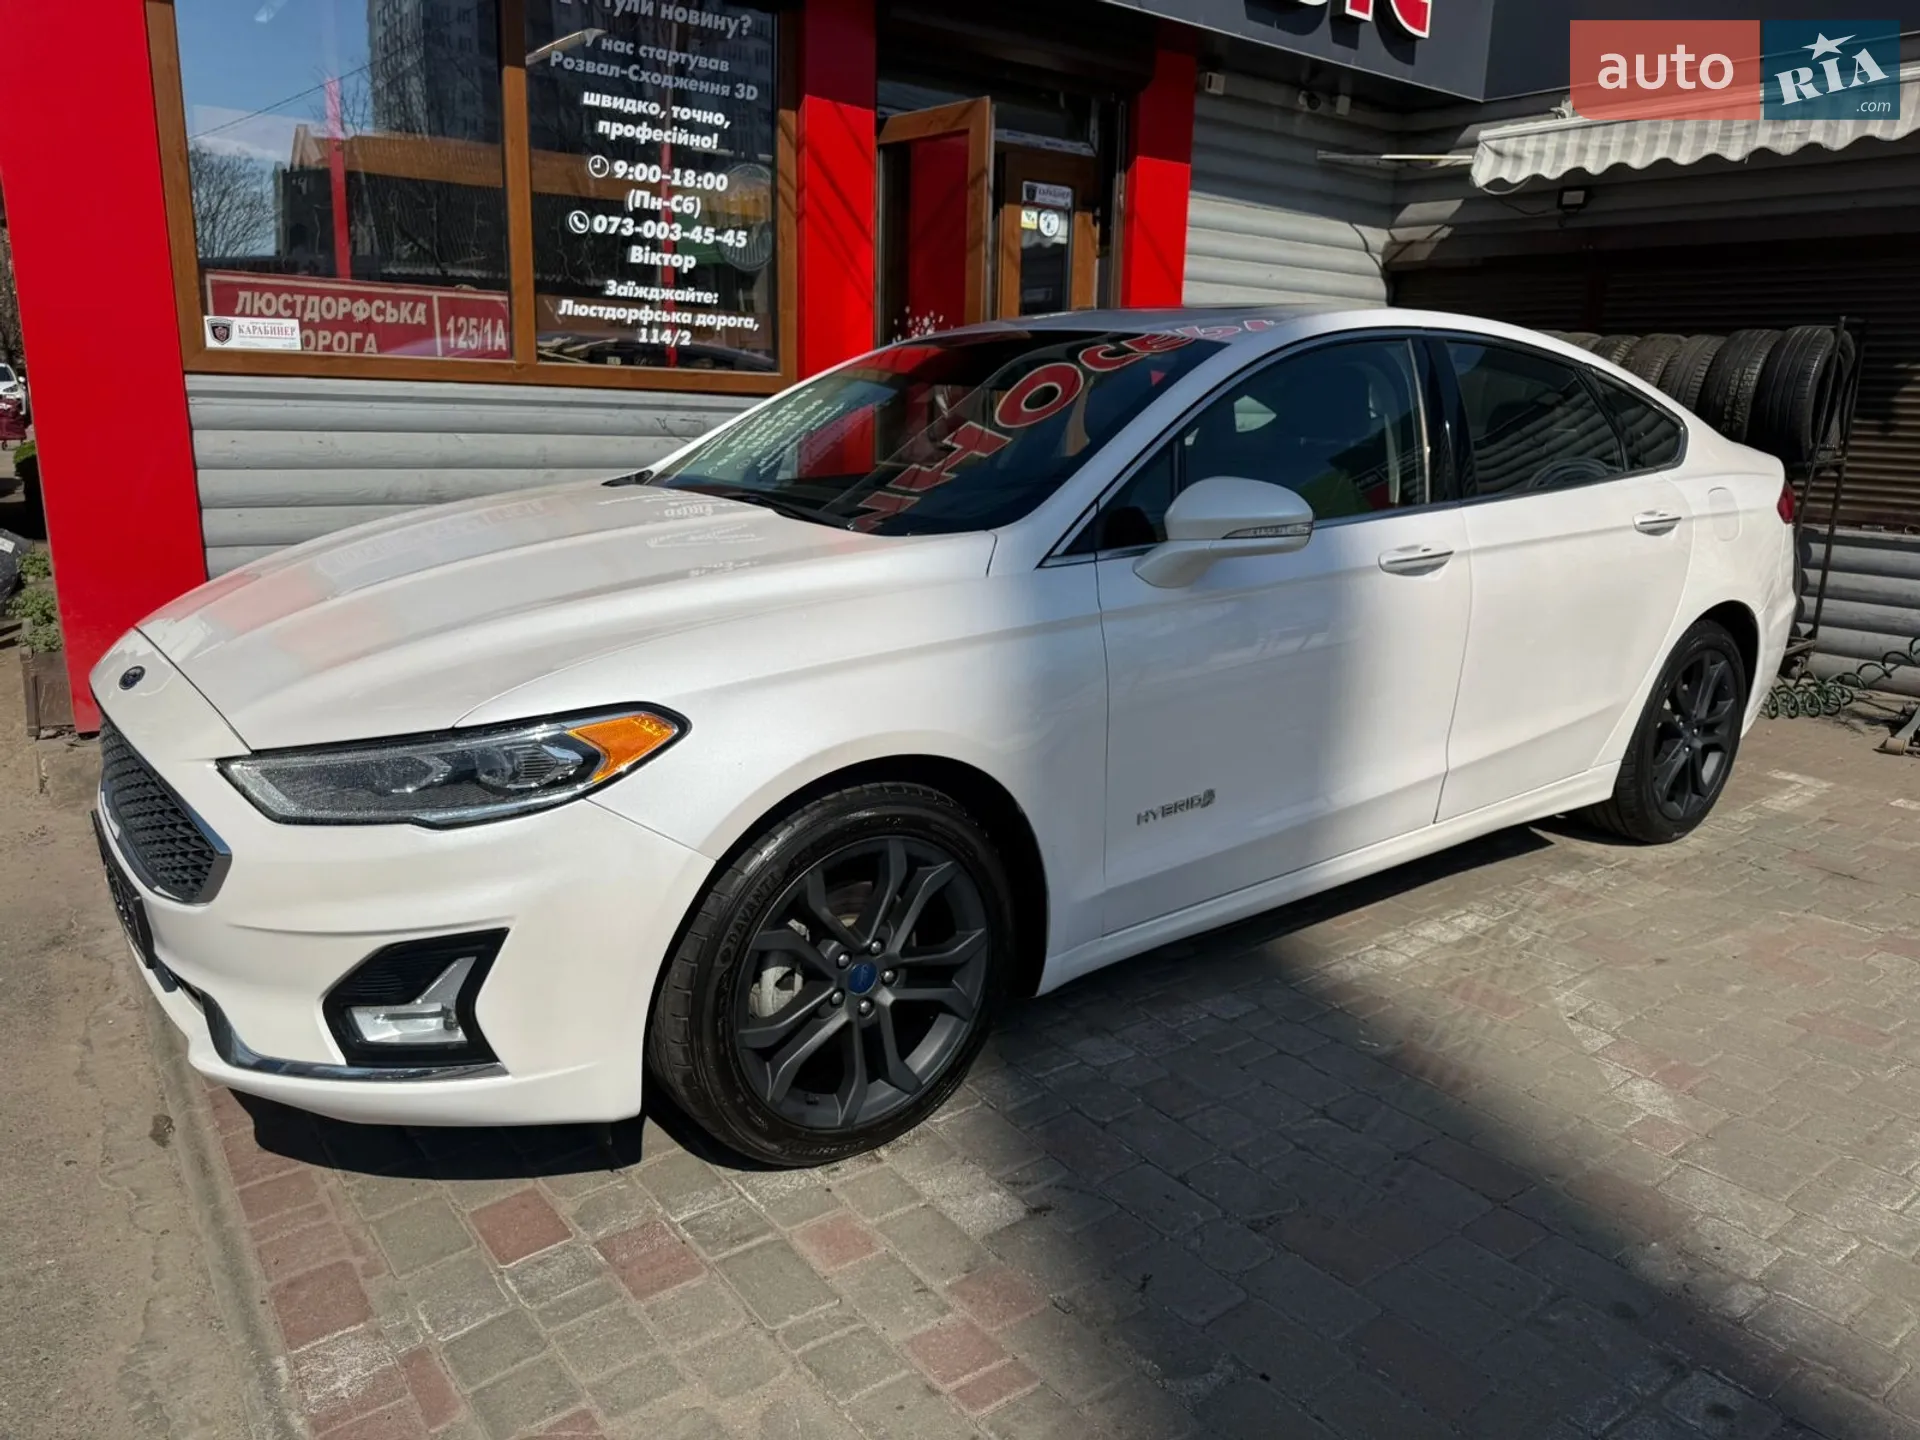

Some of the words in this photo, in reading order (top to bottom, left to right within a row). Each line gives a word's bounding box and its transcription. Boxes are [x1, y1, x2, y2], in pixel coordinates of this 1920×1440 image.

[660, 3, 752, 39] новину?
[601, 37, 635, 56] нас
[638, 45, 730, 73] стартував
[550, 51, 731, 97] Розвал-Сходження
[734, 83, 758, 101] 3D
[583, 91, 666, 119] швидко,
[671, 104, 731, 128] точно,
[598, 119, 719, 150] професійно!
[627, 189, 702, 218] (Пн-Сб)
[593, 215, 748, 248] 073-003-45-45
[630, 247, 697, 273] Віктор
[235, 290, 427, 325] ЛЮСТДОРФСЬКА
[605, 280, 719, 304] Заїжджайте:
[558, 299, 692, 325] Люстдорфська
[695, 312, 760, 331] дорога,
[302, 329, 378, 354] ОРОГА
[446, 315, 508, 351] 125/1А
[638, 330, 692, 346] 114/2
